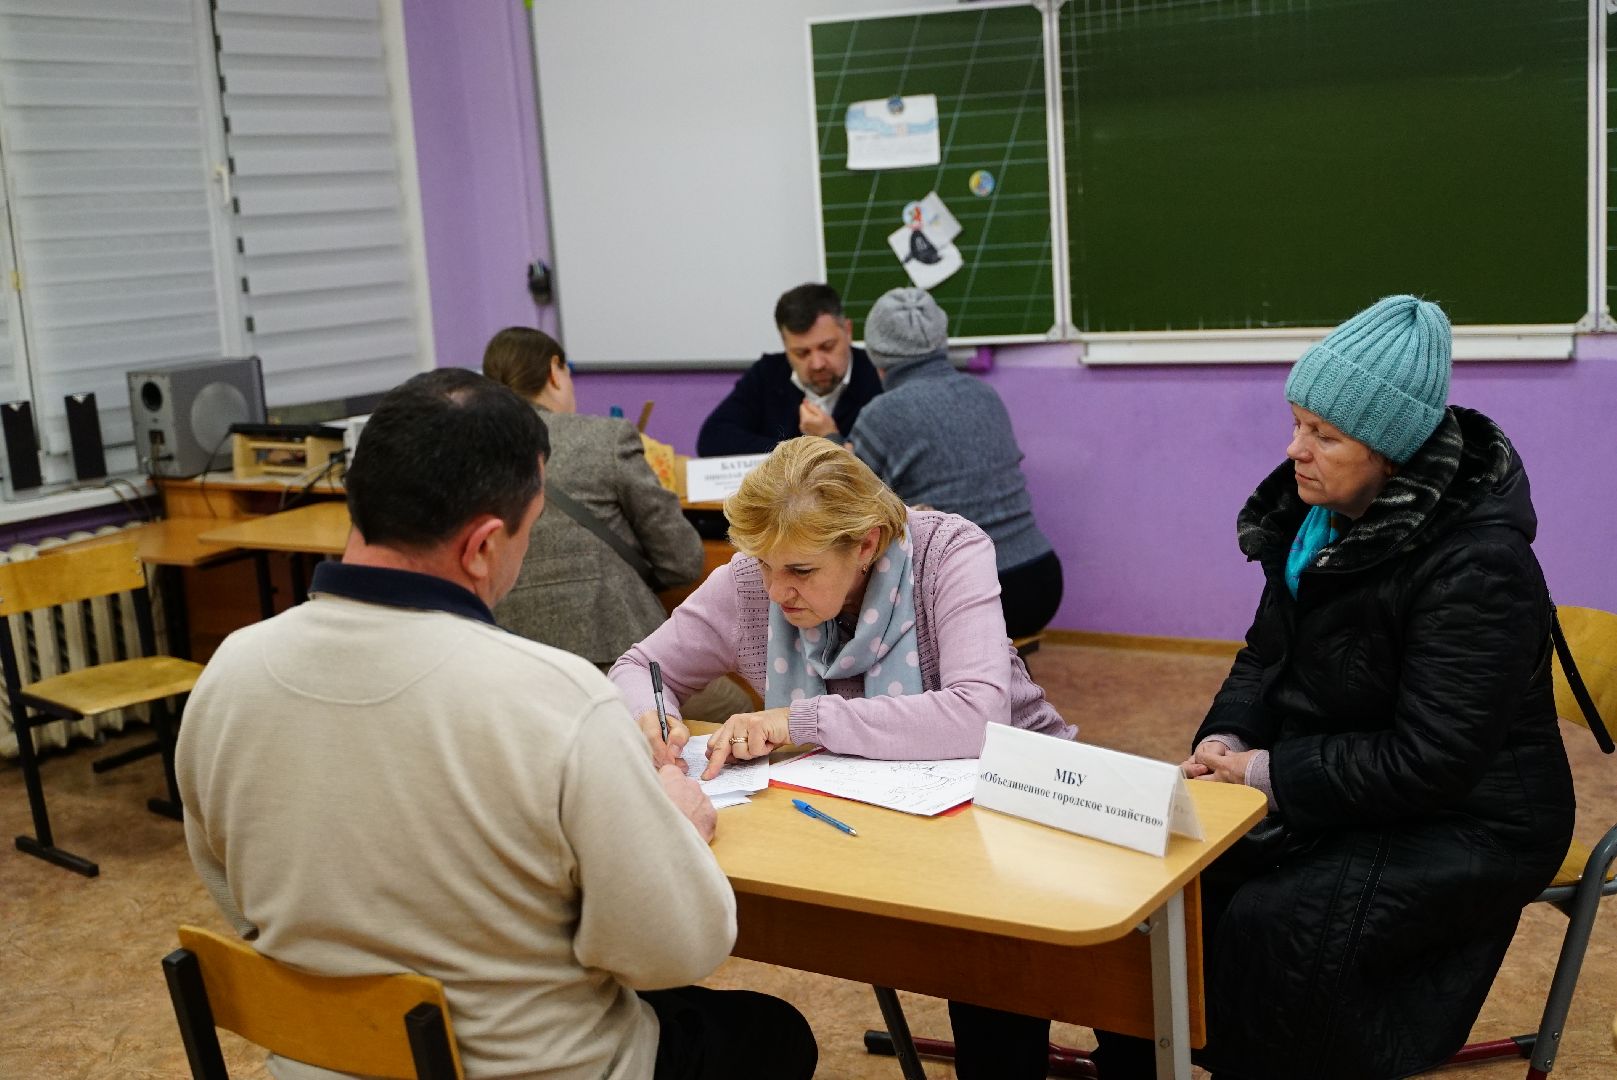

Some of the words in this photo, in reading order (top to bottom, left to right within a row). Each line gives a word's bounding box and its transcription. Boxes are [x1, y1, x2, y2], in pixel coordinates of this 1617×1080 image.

[1053, 768, 1087, 787] МБУ
[980, 771, 1050, 797] «Объединенное
[1052, 791, 1102, 811] городское
[1104, 804, 1163, 827] хозяйство»
